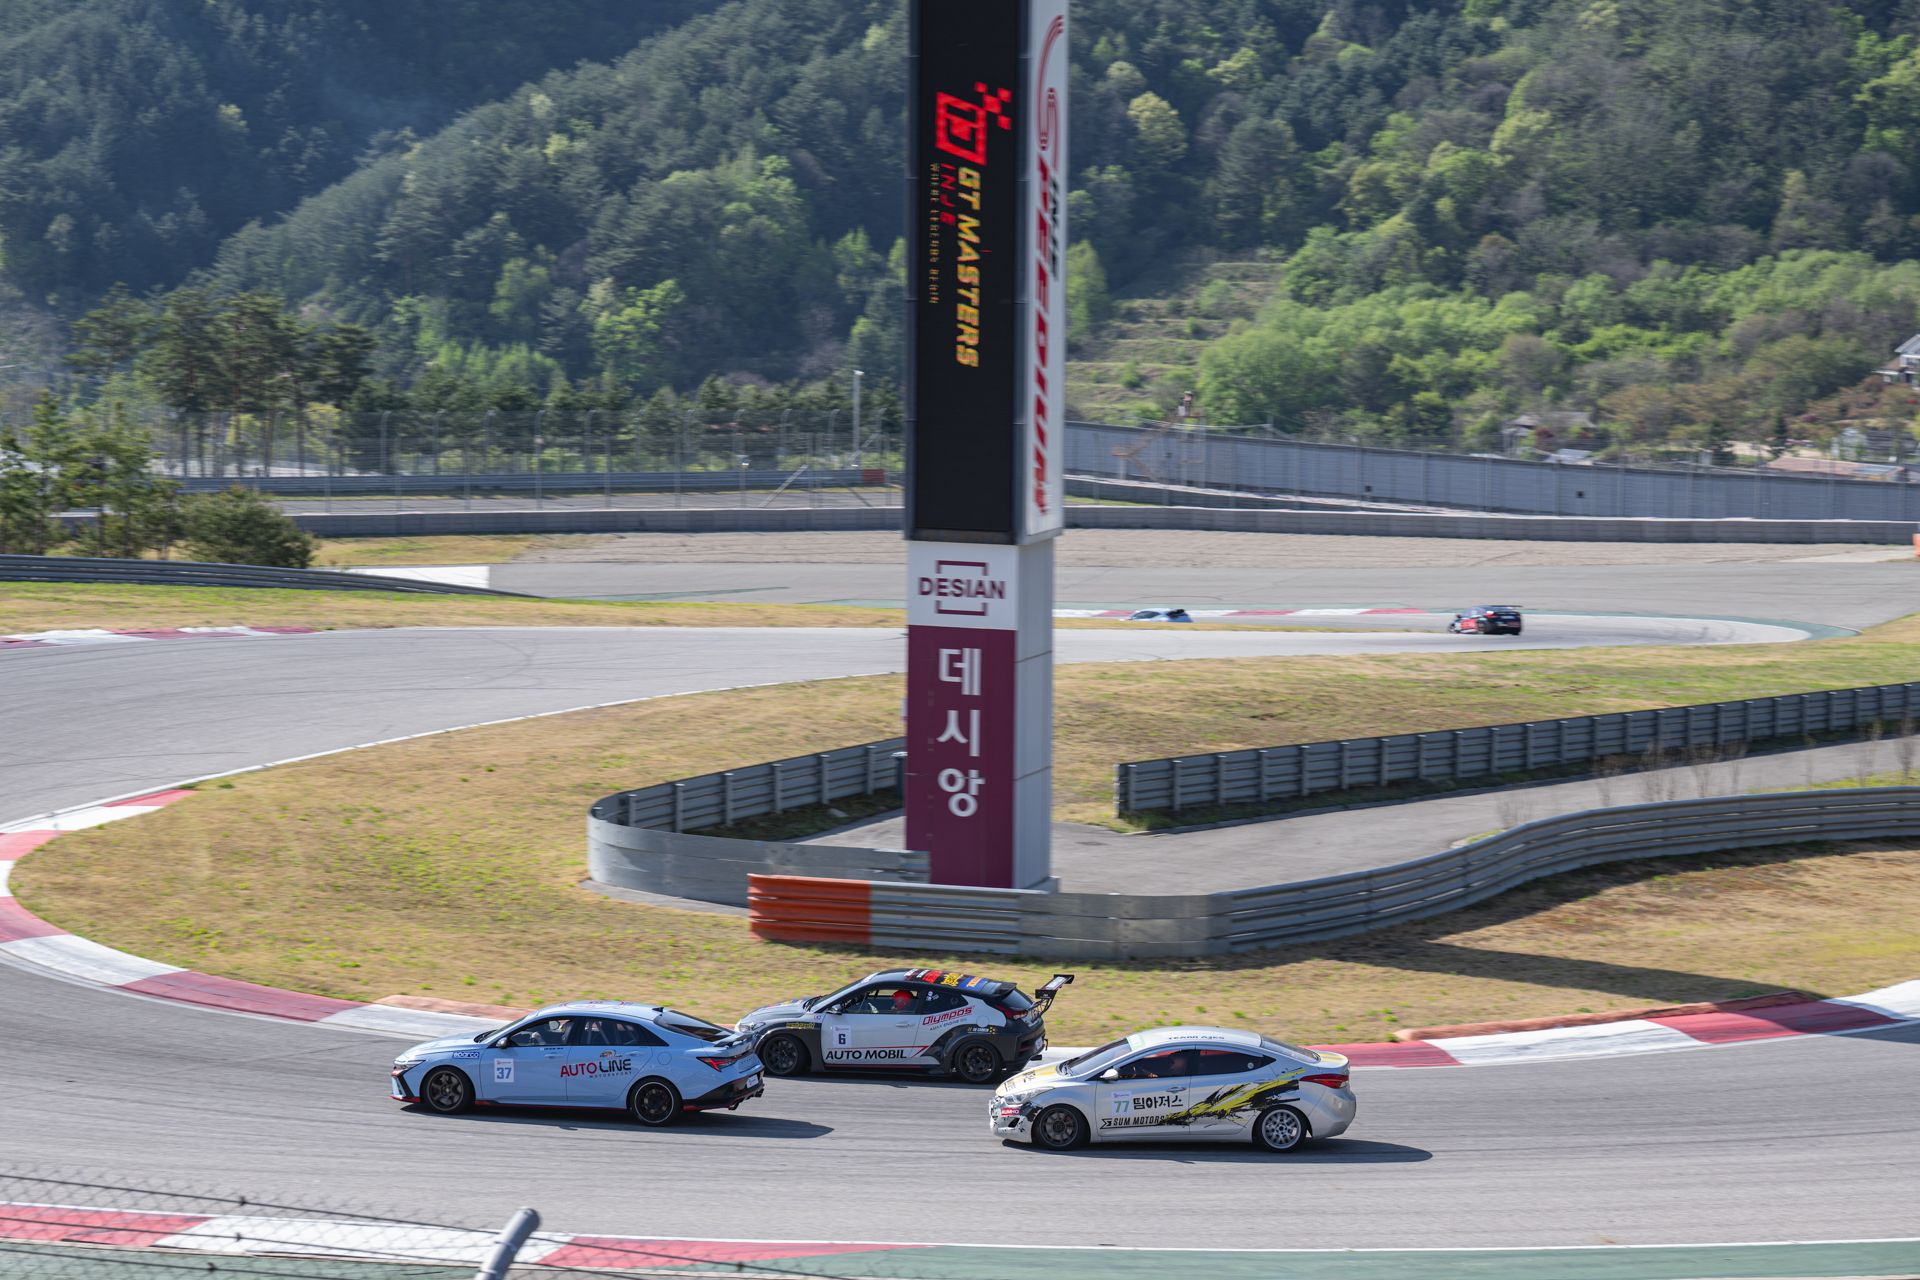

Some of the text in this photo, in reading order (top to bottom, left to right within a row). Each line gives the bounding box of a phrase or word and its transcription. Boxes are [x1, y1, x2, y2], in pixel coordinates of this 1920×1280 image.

[940, 163, 956, 225] INJE
[956, 167, 981, 367] GT MASTERS
[918, 577, 1006, 599] DESIAN
[936, 647, 986, 817] 데시앙
[838, 1033, 847, 1045] 6
[825, 1049, 907, 1060] AUTO MOBIL
[496, 1067, 512, 1080] 37
[560, 1059, 631, 1078] AUTO LINE
[1114, 1100, 1130, 1113] 77
[1113, 1117, 1130, 1126] SUM
